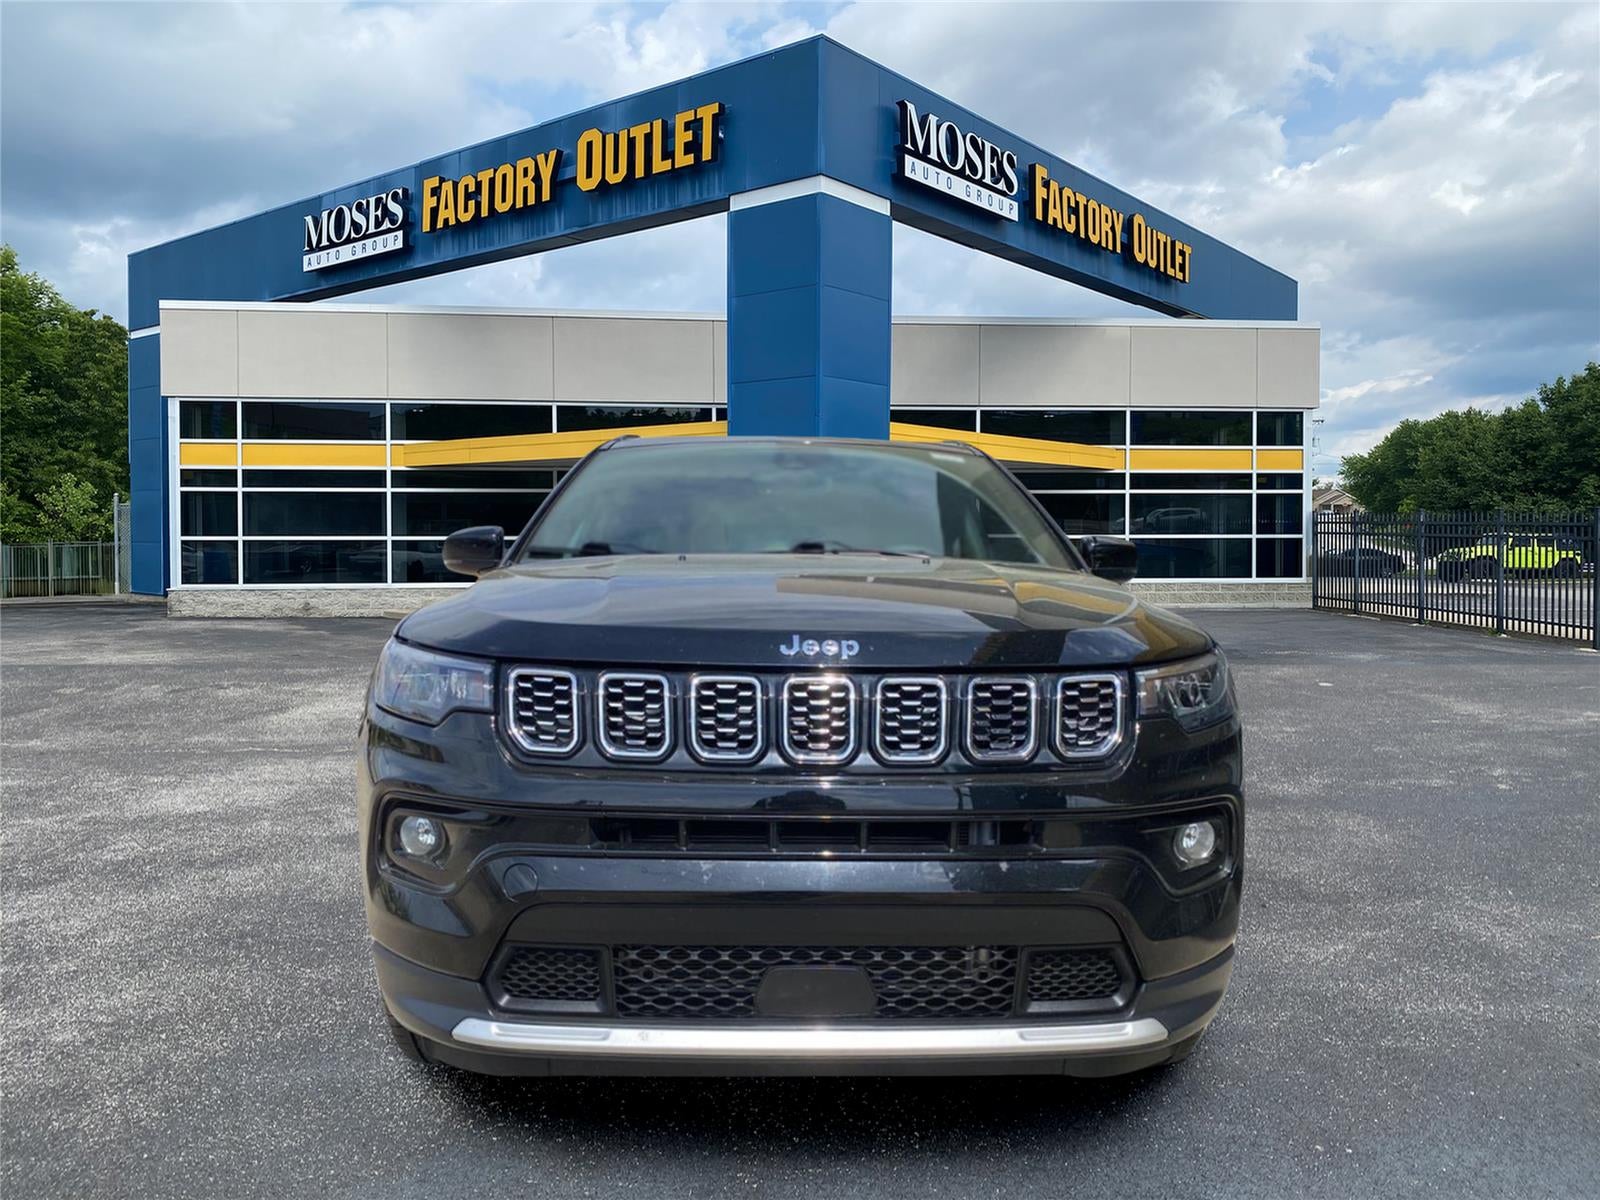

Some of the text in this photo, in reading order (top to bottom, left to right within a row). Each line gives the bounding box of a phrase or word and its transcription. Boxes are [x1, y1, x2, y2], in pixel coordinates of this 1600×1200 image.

[422, 102, 721, 233] FACTORY OUTLET
[904, 100, 1019, 197] MOSES
[303, 187, 404, 252] MOSES
[910, 161, 1015, 215] AUTO GROUP
[307, 234, 400, 268] AUTO GROUP
[1035, 163, 1192, 284] FACTORY OUTLET
[779, 634, 860, 660] Jeep
